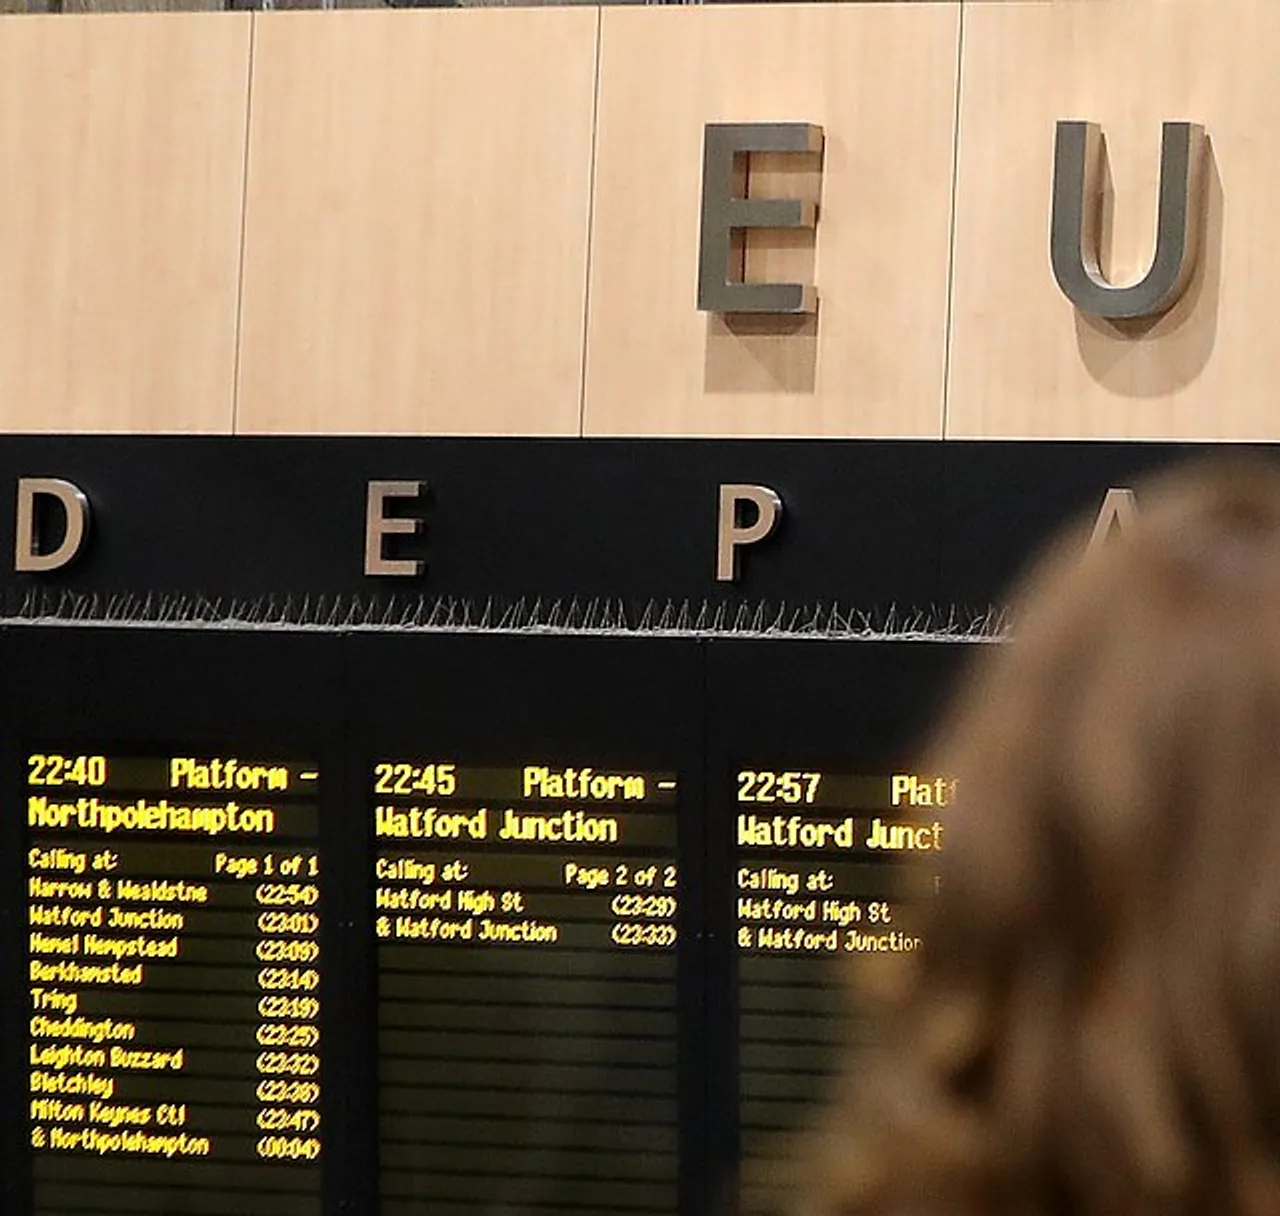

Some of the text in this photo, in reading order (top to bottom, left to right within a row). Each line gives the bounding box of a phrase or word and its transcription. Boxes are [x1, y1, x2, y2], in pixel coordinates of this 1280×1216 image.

[28, 755, 289, 790] 22:40 Platform
[374, 764, 646, 800] 22:45 Platform
[737, 771, 821, 803] 22:57
[28, 798, 275, 835] Northpolehampton
[375, 806, 619, 842] Watford Junction
[737, 814, 854, 848] Watford
[28, 849, 86, 872] Calling
[215, 854, 257, 877] Page
[263, 857, 273, 873] 1
[280, 857, 301, 875] of
[308, 858, 318, 875] 1
[375, 859, 677, 890] Calling at: Page 2 of 2
[29, 879, 92, 898] Harrow
[97, 881, 111, 899] &
[737, 868, 834, 894] Calling at:
[375, 889, 524, 915] Watford High St
[738, 898, 892, 927] Watford High St
[29, 907, 103, 926] Watford
[108, 909, 183, 929] Junction
[375, 919, 558, 942] & Watford Junction
[29, 935, 80, 954] Hemel
[84, 938, 178, 959] Hempstead
[737, 927, 837, 950] & Watford
[30, 989, 78, 1012] Tring
[30, 1018, 135, 1041] Cheddington
[30, 1046, 105, 1069] Leighton
[110, 1049, 184, 1070] Buzzard
[30, 1074, 114, 1098] Bletchley
[31, 1102, 84, 1122] Milton
[89, 1103, 151, 1125] Keynes
[32, 1130, 46, 1147] &
[50, 1131, 209, 1155] Northpolehampton
